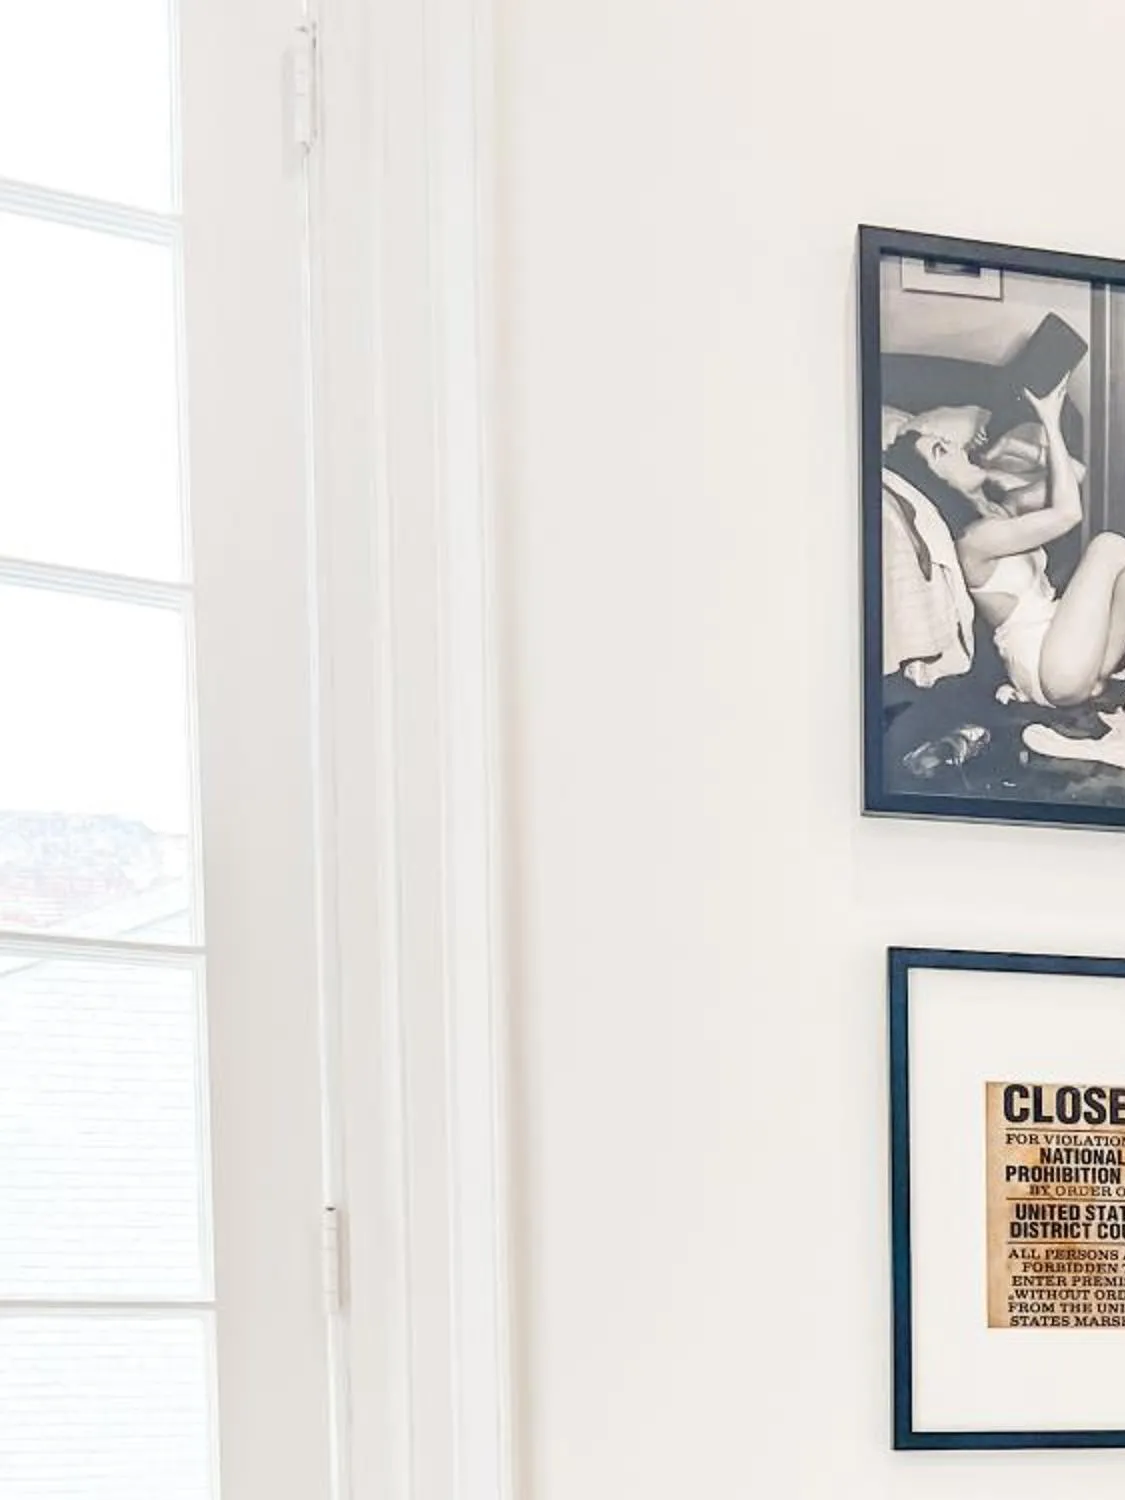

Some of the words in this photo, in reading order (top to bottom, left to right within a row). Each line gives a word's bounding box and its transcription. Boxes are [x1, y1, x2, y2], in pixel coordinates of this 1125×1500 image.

[1005, 1133, 1040, 1145] FOR
[1040, 1148, 1125, 1166] NATIONAL
[1005, 1165, 1121, 1184] PROHIBITION
[1029, 1185, 1052, 1195] BY
[1055, 1185, 1112, 1196] ORDER
[1015, 1203, 1080, 1221] UNITED
[1010, 1222, 1092, 1239] DISTRICT
[1008, 1249, 1040, 1259] ALL
[1045, 1249, 1119, 1260] PERSONS
[1022, 1262, 1118, 1273] FORBIDDEN
[1012, 1275, 1067, 1286] ENTER
[1014, 1289, 1090, 1300] WITHOUT
[1008, 1302, 1055, 1313] FROM
[1060, 1302, 1092, 1313] THE
[1010, 1316, 1070, 1327] STATES
